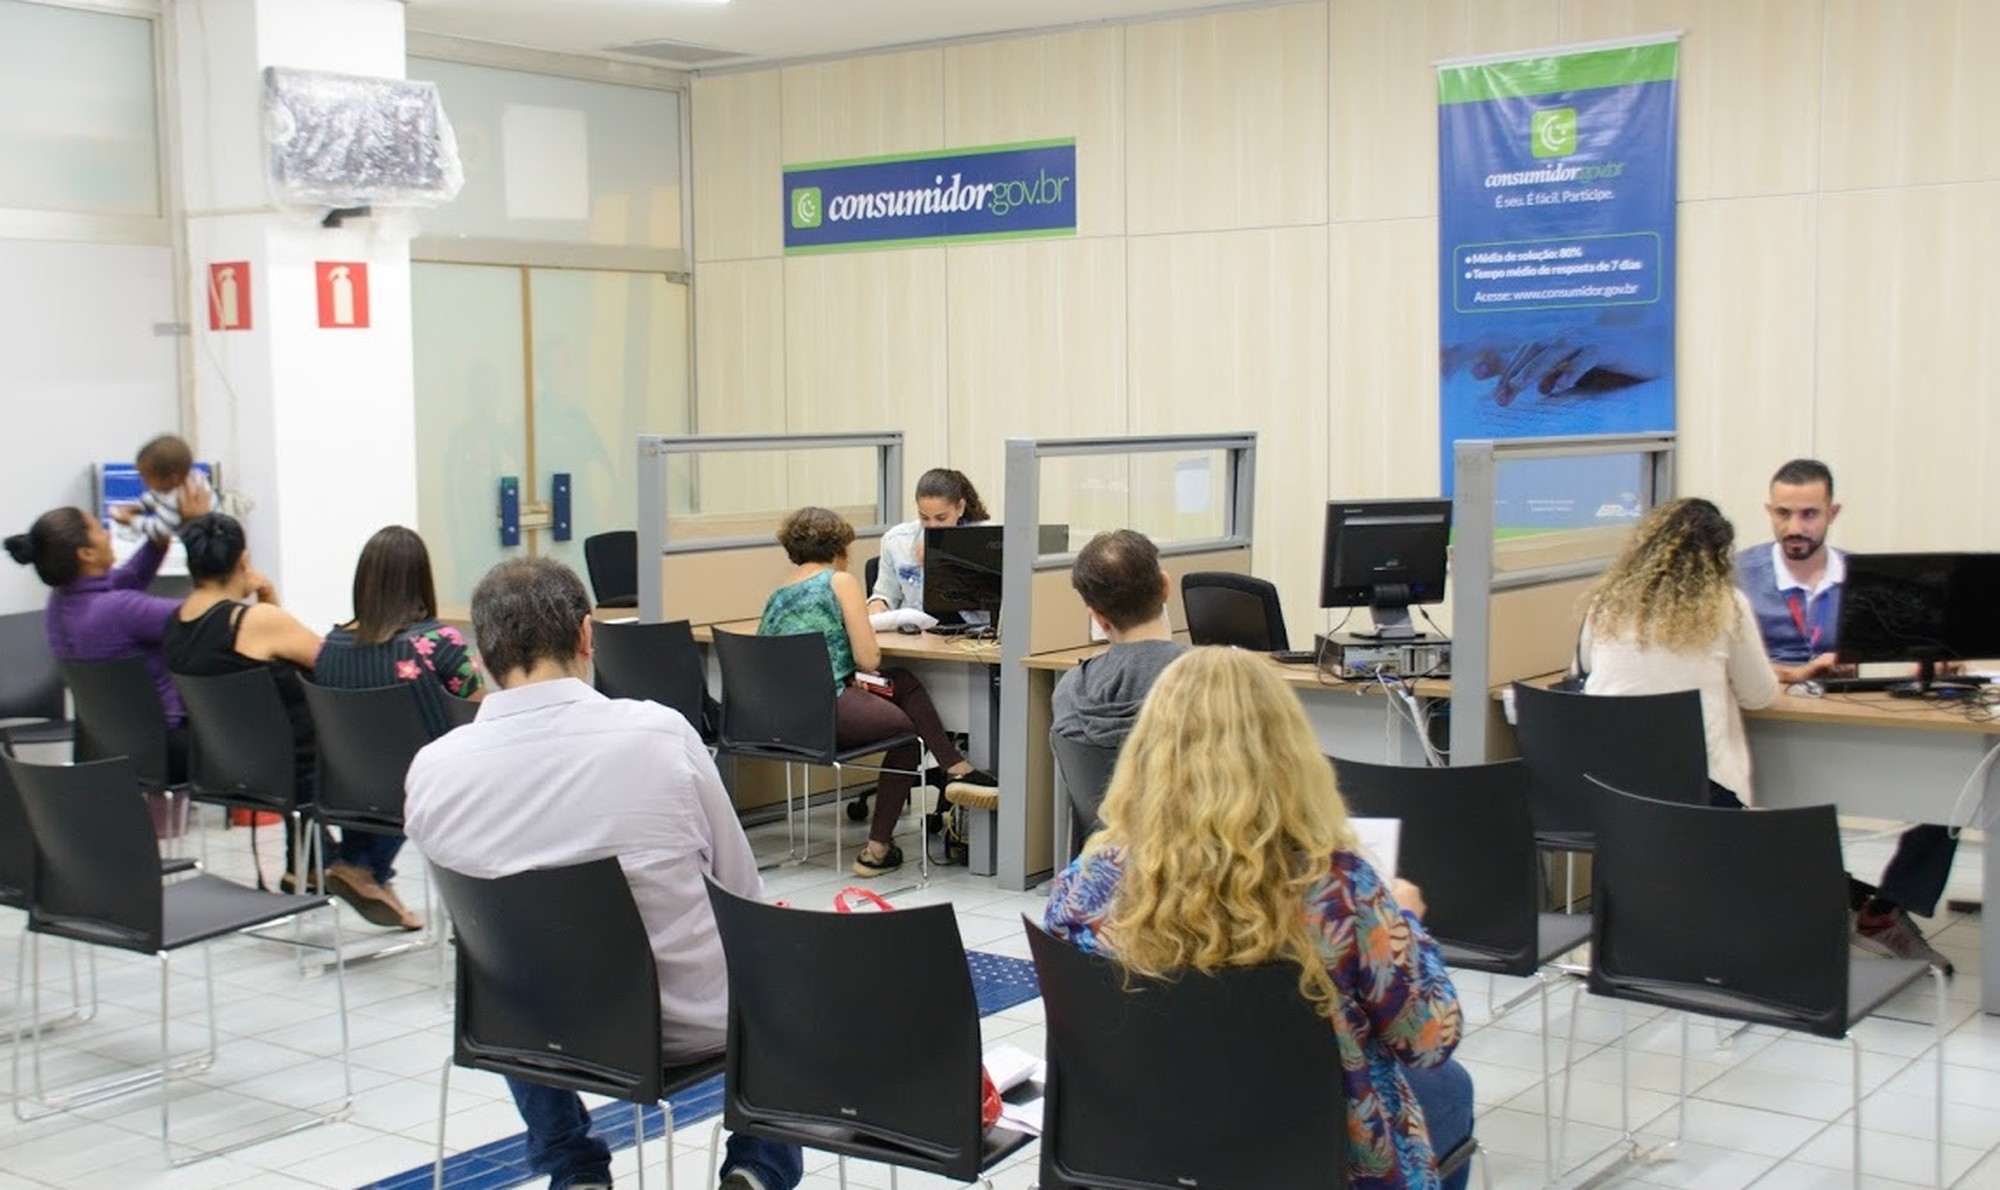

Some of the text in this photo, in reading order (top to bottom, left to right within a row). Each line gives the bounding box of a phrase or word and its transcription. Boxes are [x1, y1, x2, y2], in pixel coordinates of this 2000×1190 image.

[1484, 163, 1624, 187] consumidor.gov.br
[828, 167, 1069, 221] consumidor.gov.br
[1494, 194, 1503, 208] É
[1527, 191, 1534, 206] É
[1562, 188, 1615, 203] Participe.
[1472, 251, 1503, 264] Média
[1504, 251, 1516, 261] de
[1473, 258, 1642, 280] Tempo médio de resposta de 7 dias
[1474, 282, 1639, 303] Acesse: www.consumidor.gov.br
